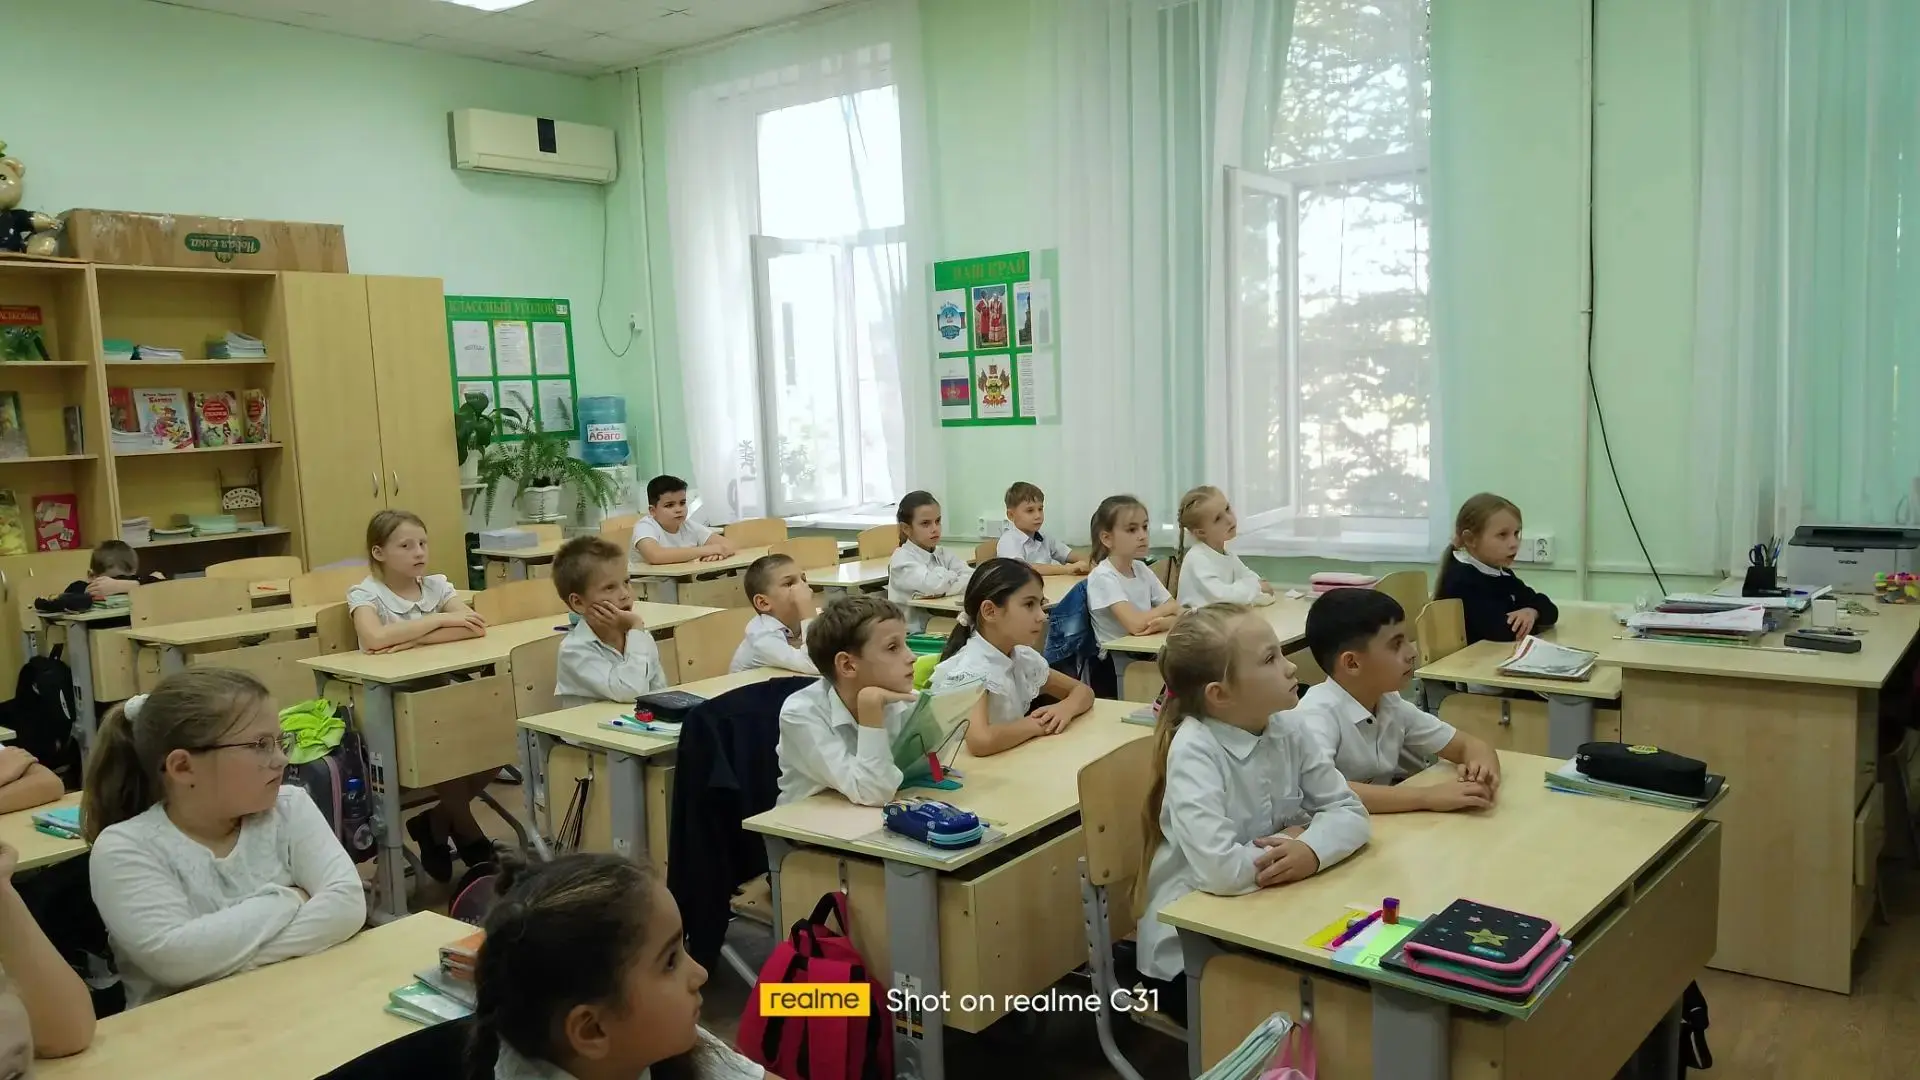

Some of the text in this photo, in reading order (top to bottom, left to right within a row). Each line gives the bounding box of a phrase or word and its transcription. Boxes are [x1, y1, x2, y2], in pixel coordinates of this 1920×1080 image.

[987, 256, 1025, 279] КРАЙ
[448, 300, 555, 315] КЛАССНЫЙ УГОЛОК
